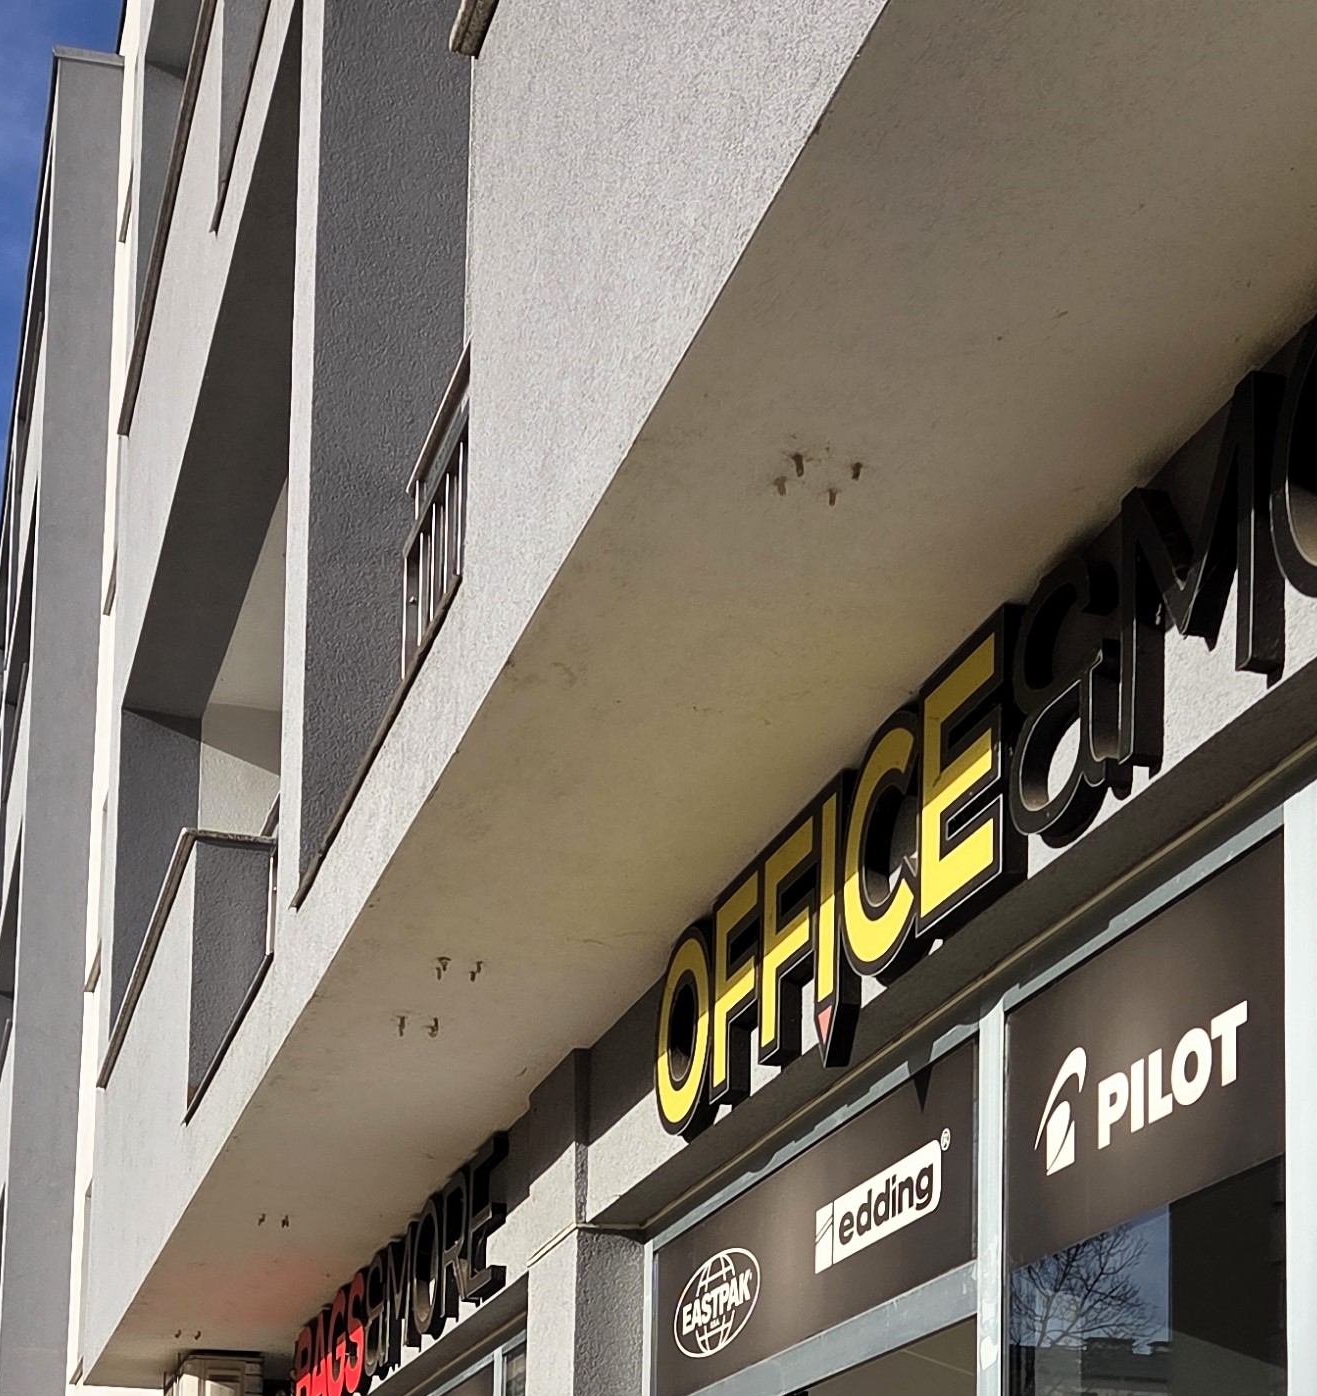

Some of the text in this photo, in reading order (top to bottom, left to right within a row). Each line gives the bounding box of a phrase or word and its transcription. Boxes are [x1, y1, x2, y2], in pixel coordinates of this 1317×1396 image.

[1097, 1000, 1248, 1149] PILOT
[837, 1162, 935, 1245] edding
[682, 1269, 752, 1336] EASTPAK
